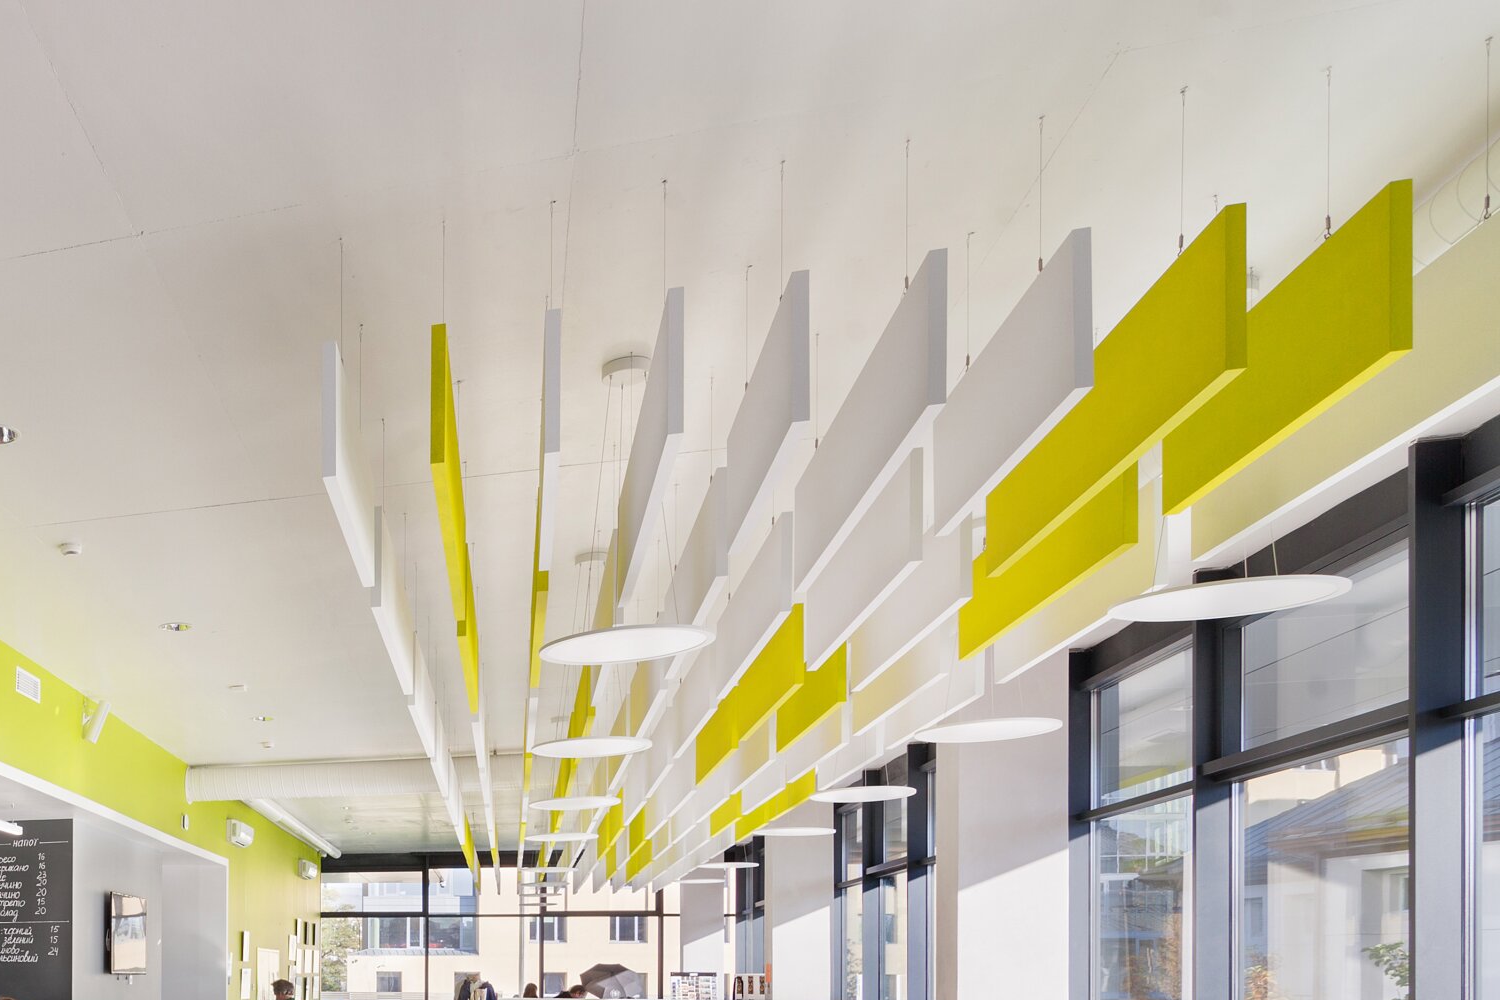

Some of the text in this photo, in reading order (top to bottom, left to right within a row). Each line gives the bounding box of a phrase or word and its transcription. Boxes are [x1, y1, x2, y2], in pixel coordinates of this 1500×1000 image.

[35, 907, 47, 915] 20
[50, 925, 60, 933] 15
[50, 936, 59, 944] 15
[47, 947, 59, 956] 24
